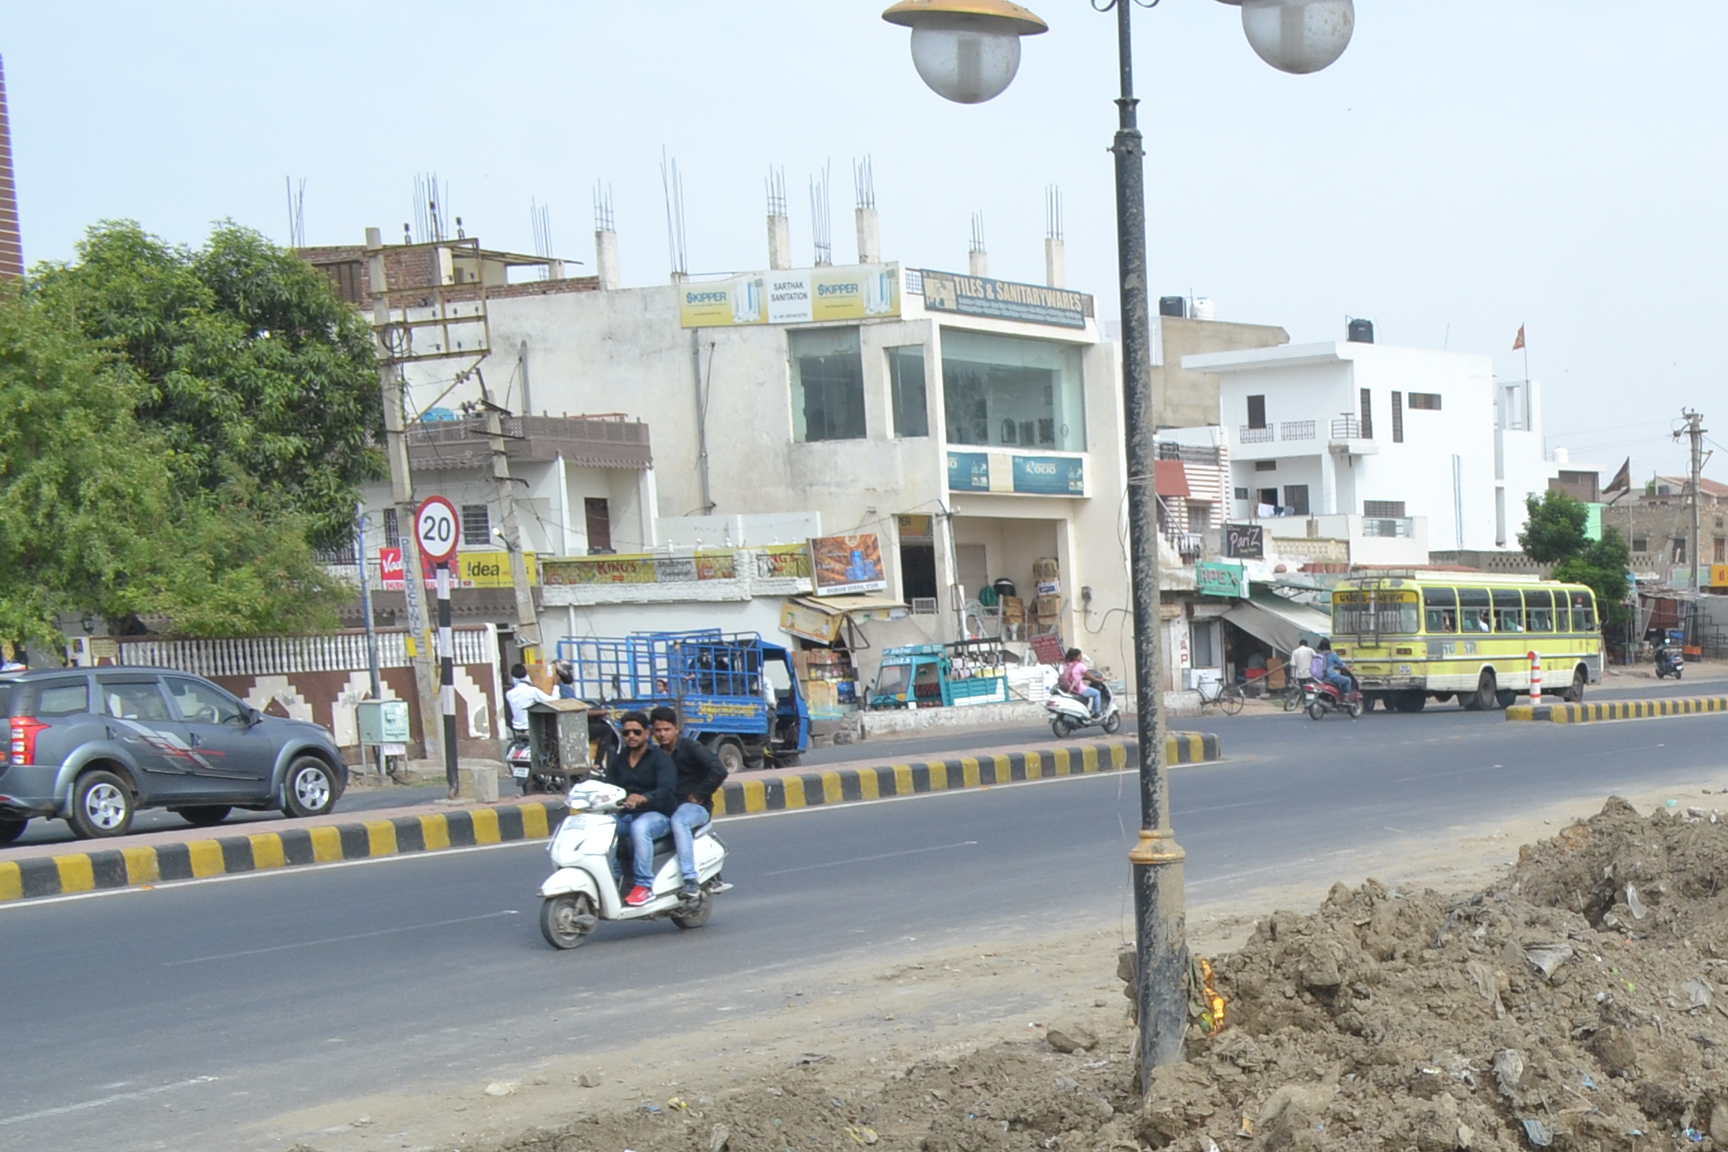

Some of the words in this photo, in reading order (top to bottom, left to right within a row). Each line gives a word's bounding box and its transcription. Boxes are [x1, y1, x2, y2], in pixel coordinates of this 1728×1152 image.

[773, 281, 804, 291] SARTHAK
[817, 282, 859, 298] SKIPPER
[686, 291, 727, 304] SKIPPER
[771, 292, 808, 302] SANITATION
[953, 276, 983, 298] TILES
[986, 283, 995, 299] &
[996, 282, 1082, 312] SANITARYWARES
[423, 515, 451, 542] 20
[662, 569, 691, 578] General
[1200, 568, 1239, 586] APEX
